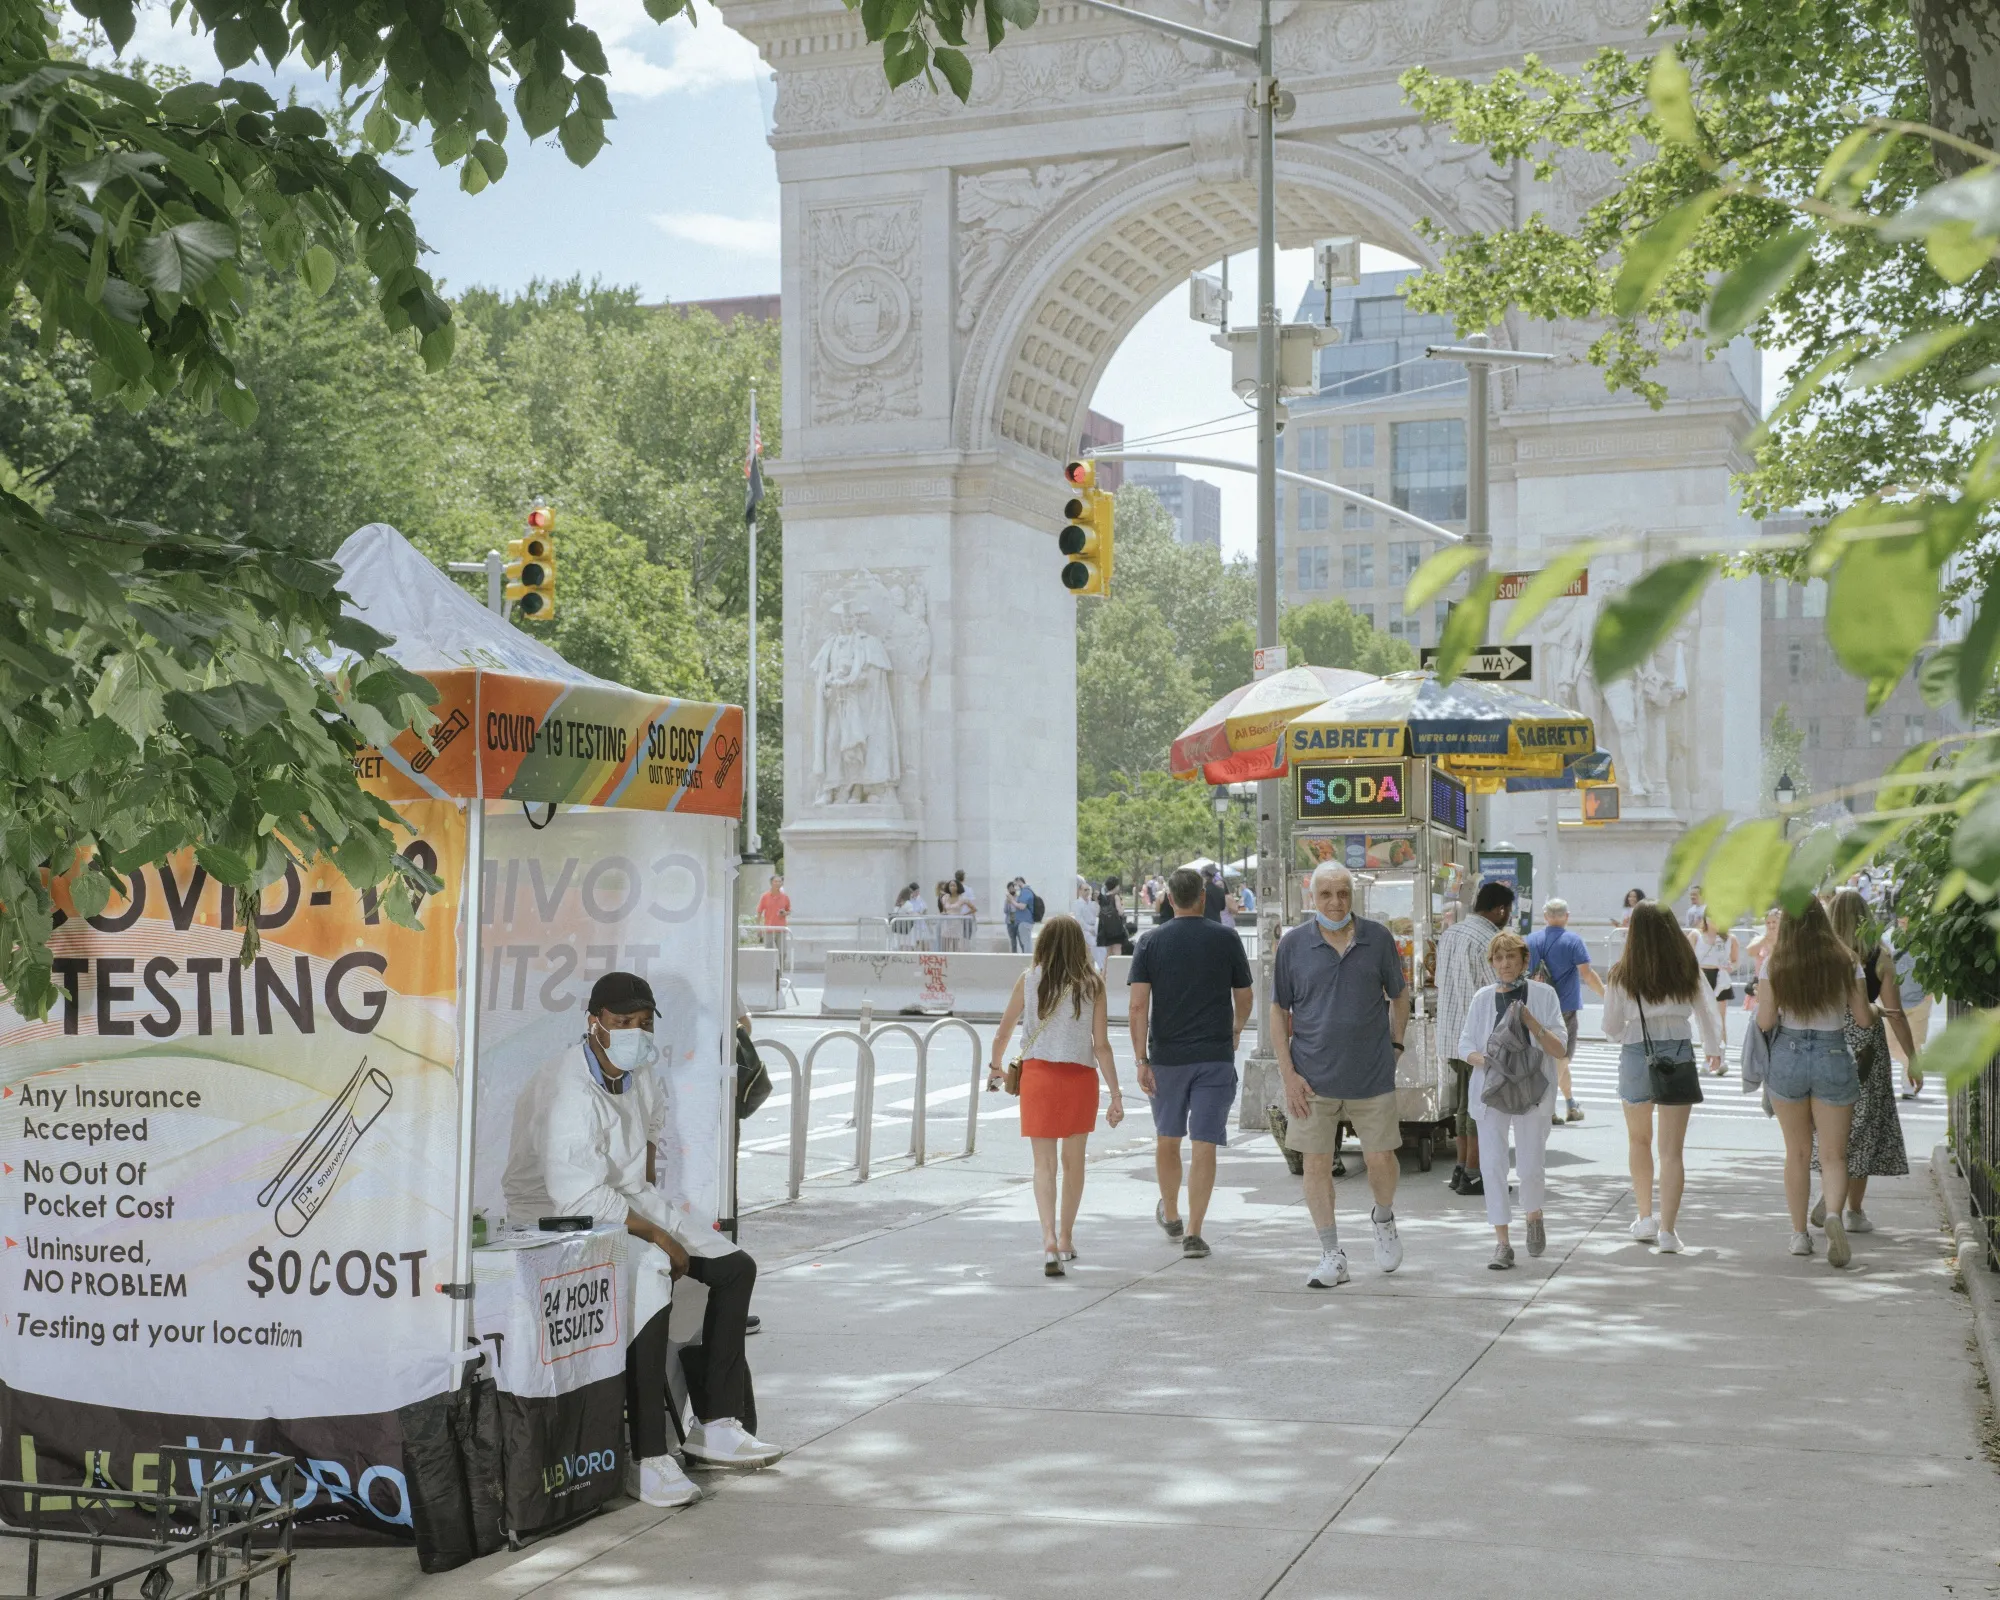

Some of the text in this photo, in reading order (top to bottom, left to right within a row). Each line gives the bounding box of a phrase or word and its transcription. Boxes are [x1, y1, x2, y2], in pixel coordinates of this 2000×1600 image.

[1482, 656, 1515, 671] WAY
[486, 711, 704, 765] COVID-19 TESTING $0 COST
[1292, 727, 1400, 751] SABRETT
[1418, 733, 1444, 743] WE'RE
[1445, 733, 1458, 743] ON
[1459, 733, 1466, 743] A
[1467, 733, 1487, 743] ROLL
[1516, 726, 1590, 748] SABRETT
[648, 764, 704, 789] OUT OF POCKET
[1304, 775, 1400, 805] SODA
[51, 950, 389, 1038] TESTING
[19, 1083, 202, 1113] Any Insurance
[23, 1116, 148, 1147] Accepted
[23, 1159, 147, 1186] No Out Of
[24, 1192, 175, 1219] Pocket Cost
[26, 1235, 152, 1267] Uninsured,
[23, 1268, 188, 1298] NO PROBLEM
[309, 1249, 428, 1299] COST
[543, 1278, 610, 1318] 24 HOUR
[17, 1312, 303, 1348] Testing at your location
[549, 1308, 604, 1347] RESULTS
